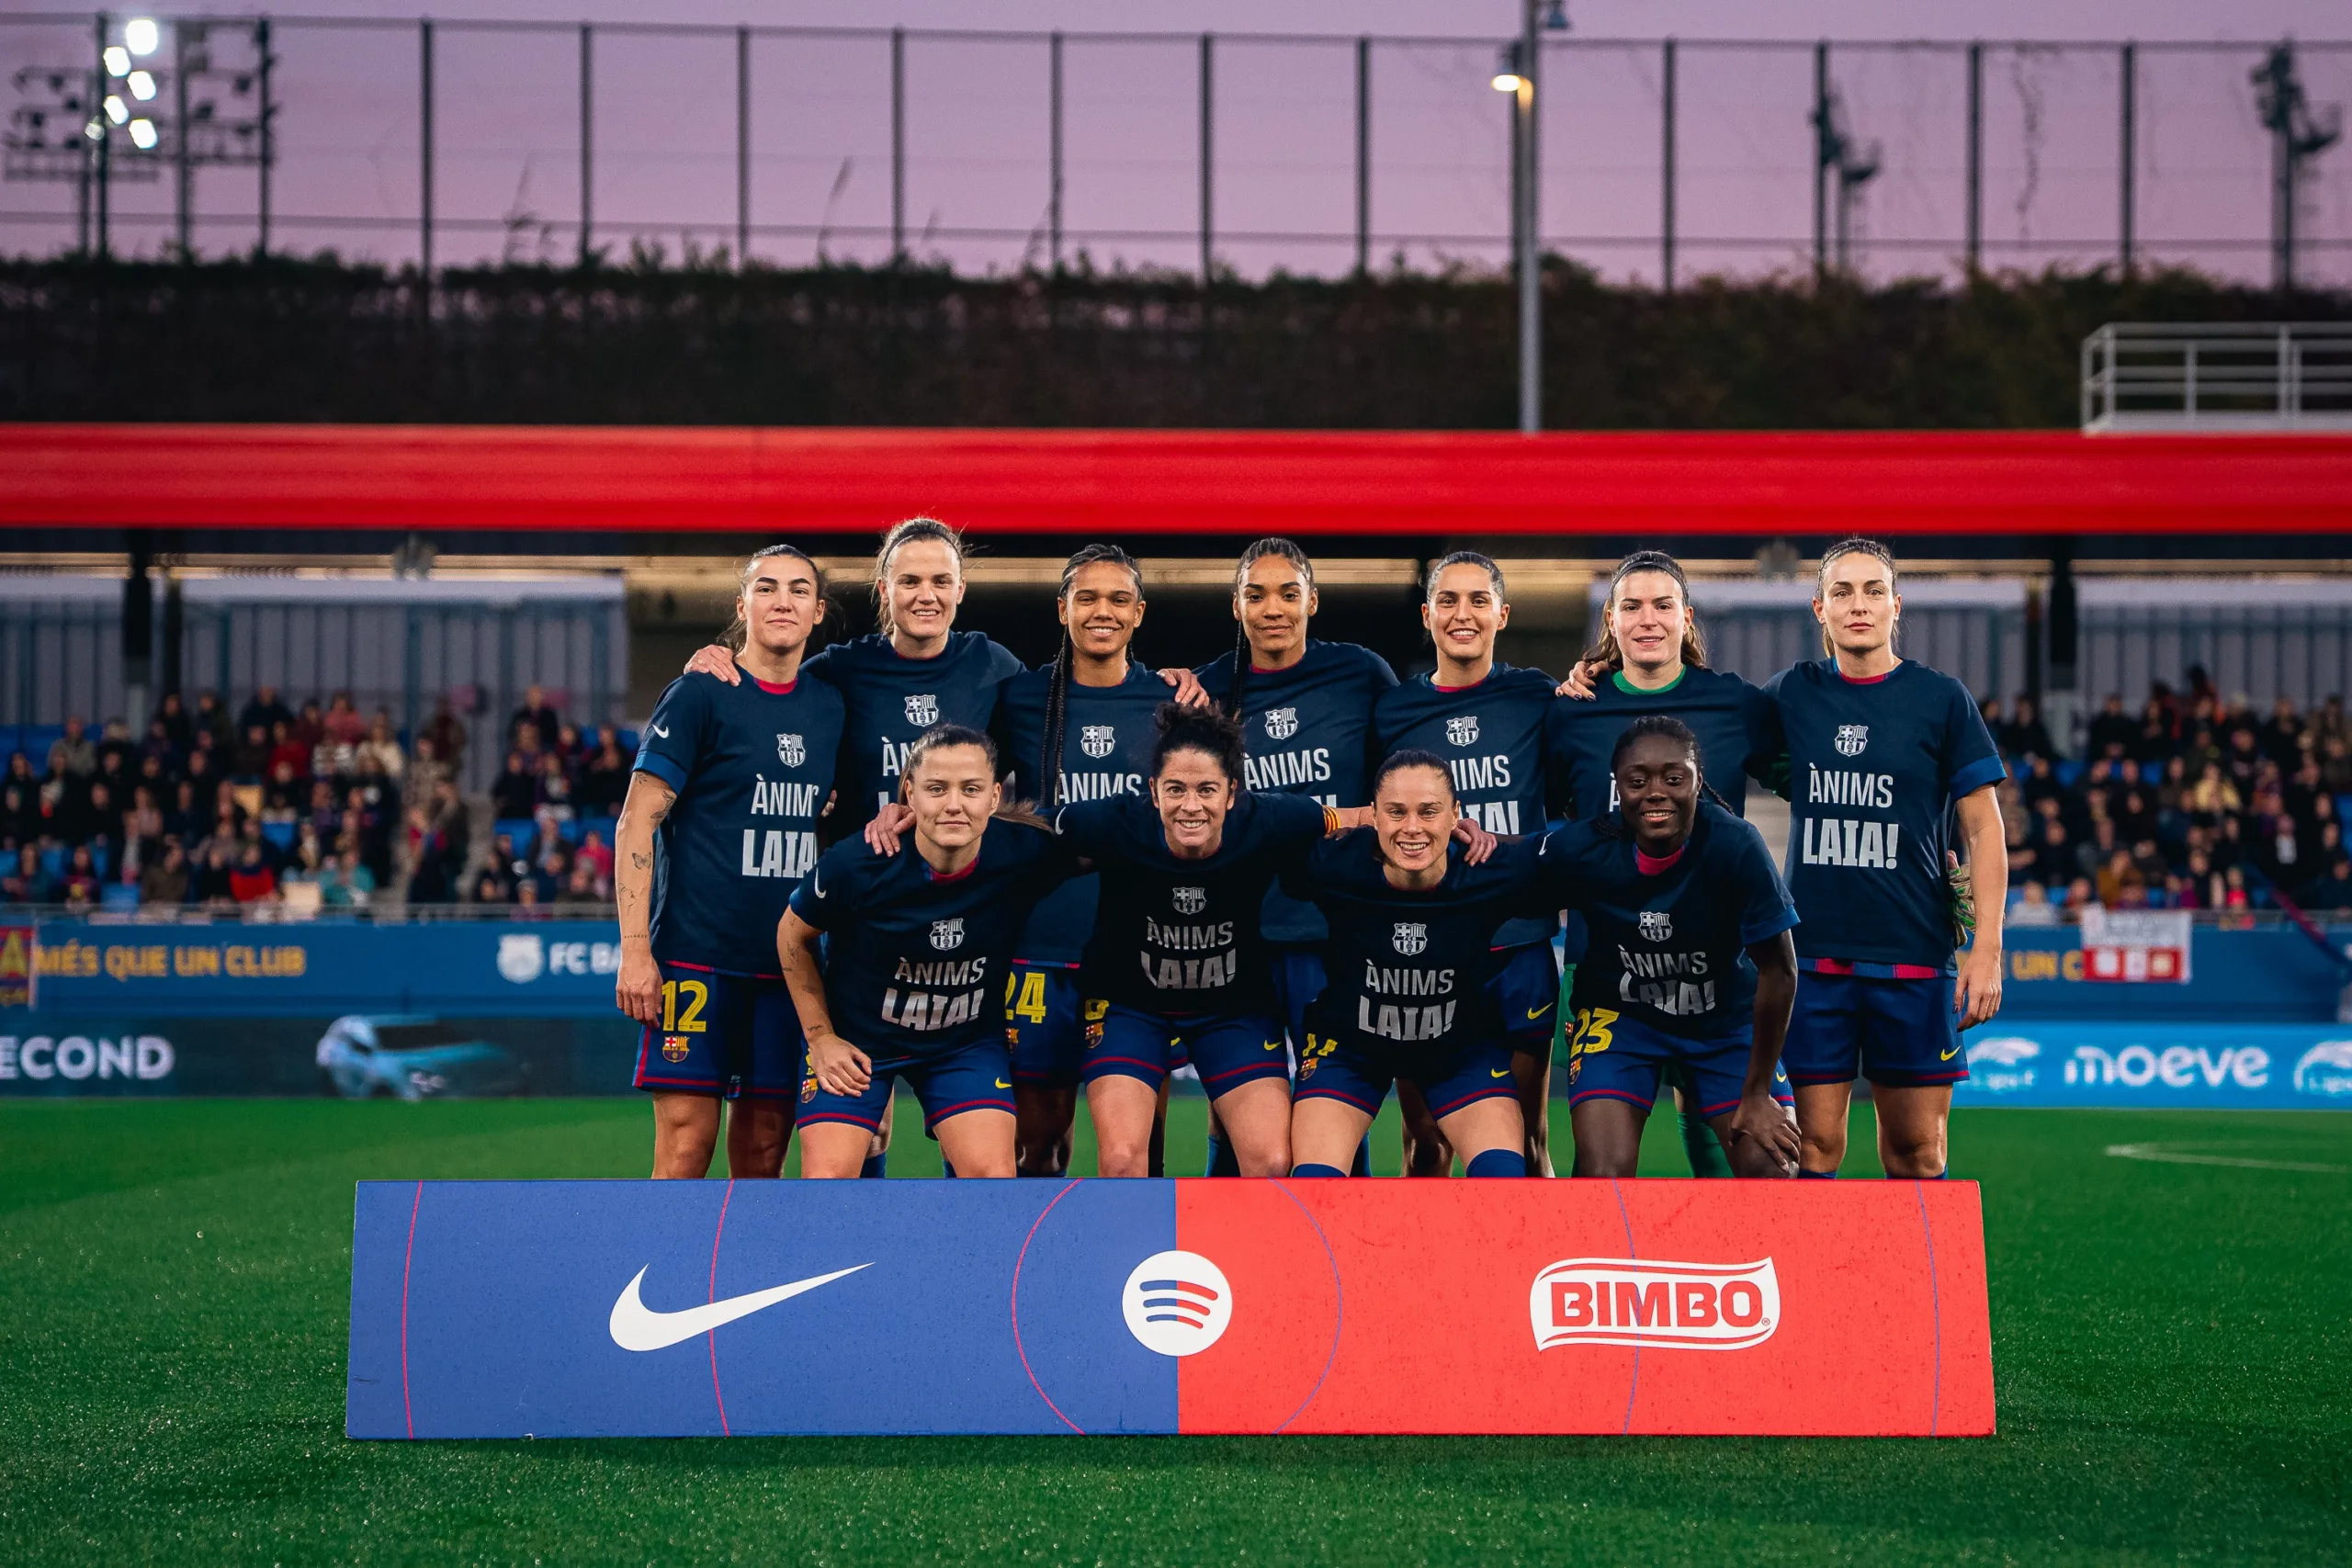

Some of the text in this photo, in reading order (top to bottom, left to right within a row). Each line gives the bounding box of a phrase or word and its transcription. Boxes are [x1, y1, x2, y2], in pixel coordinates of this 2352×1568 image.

[1243, 748, 1331, 790] ÀNIMS
[1808, 762, 1894, 807] ÀNIMS
[742, 829, 818, 879] LAIA
[1803, 818, 1899, 870] LAIA!
[1147, 916, 1233, 950] ÀNIMS
[34, 938, 307, 982] MÉS QUE UN CLUB
[549, 942, 589, 976] FC
[894, 956, 987, 986] ÀNIMS
[1140, 948, 1236, 989] LAIA!
[1365, 958, 1455, 996] ÀNIMS
[1618, 944, 1708, 978] ÀNIMS
[2011, 949, 2059, 981] UN
[662, 979, 707, 1032] 12
[882, 987, 984, 1031] LAIA!
[1619, 971, 1715, 1016] LAIA!
[1359, 995, 1456, 1041] LAIA!
[1569, 1007, 1620, 1059] 23
[2064, 1045, 2270, 1089] moeve
[1550, 1280, 1764, 1328] BIMBO
